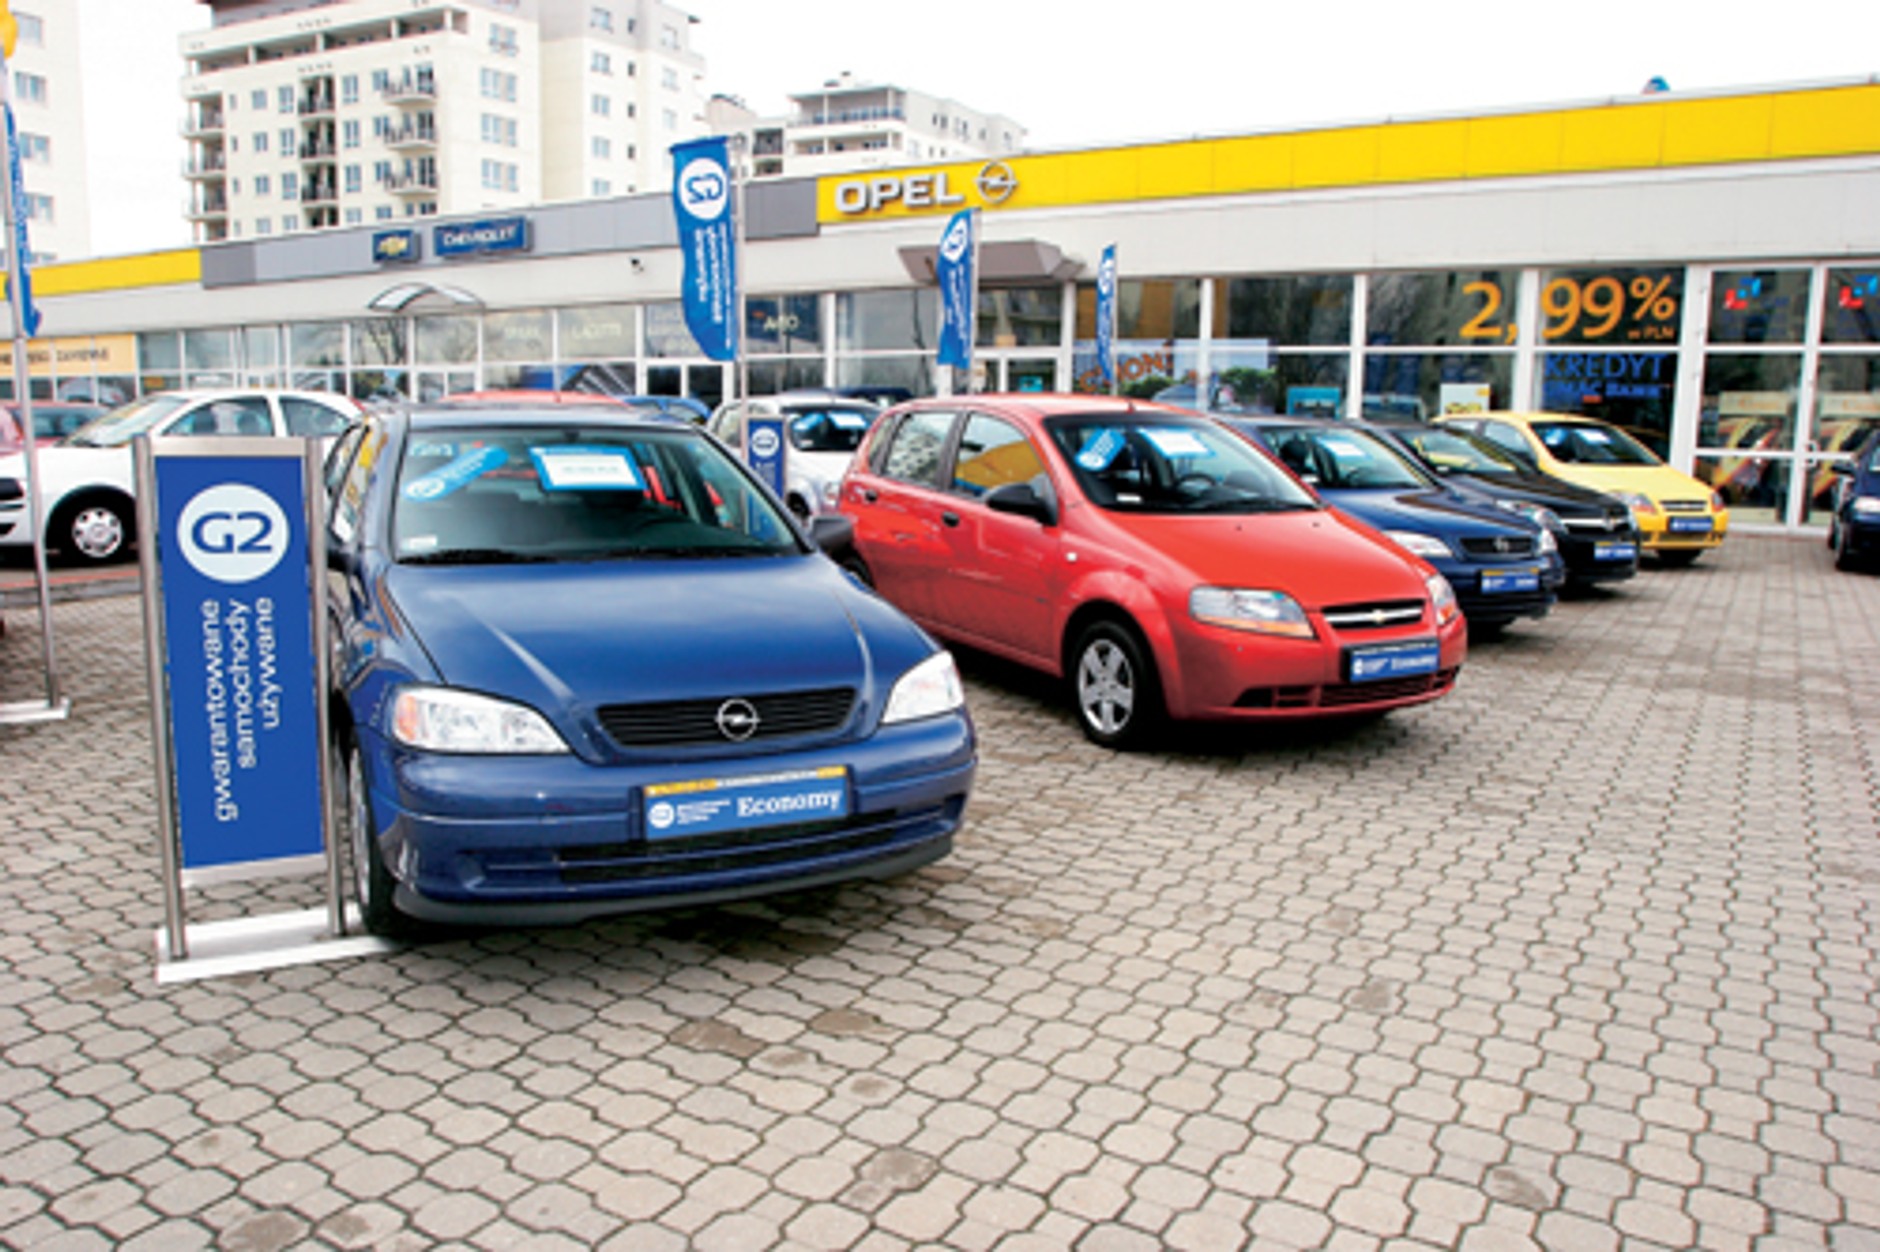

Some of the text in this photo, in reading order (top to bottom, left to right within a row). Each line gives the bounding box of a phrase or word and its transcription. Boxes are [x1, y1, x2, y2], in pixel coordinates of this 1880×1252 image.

[835, 172, 965, 214] OPEL
[1544, 351, 1669, 379] KREDYT
[191, 511, 273, 554] G2
[225, 598, 257, 770] samochody
[255, 596, 283, 730] używane
[201, 598, 239, 822] gwarantowane
[736, 789, 844, 818] Economy
